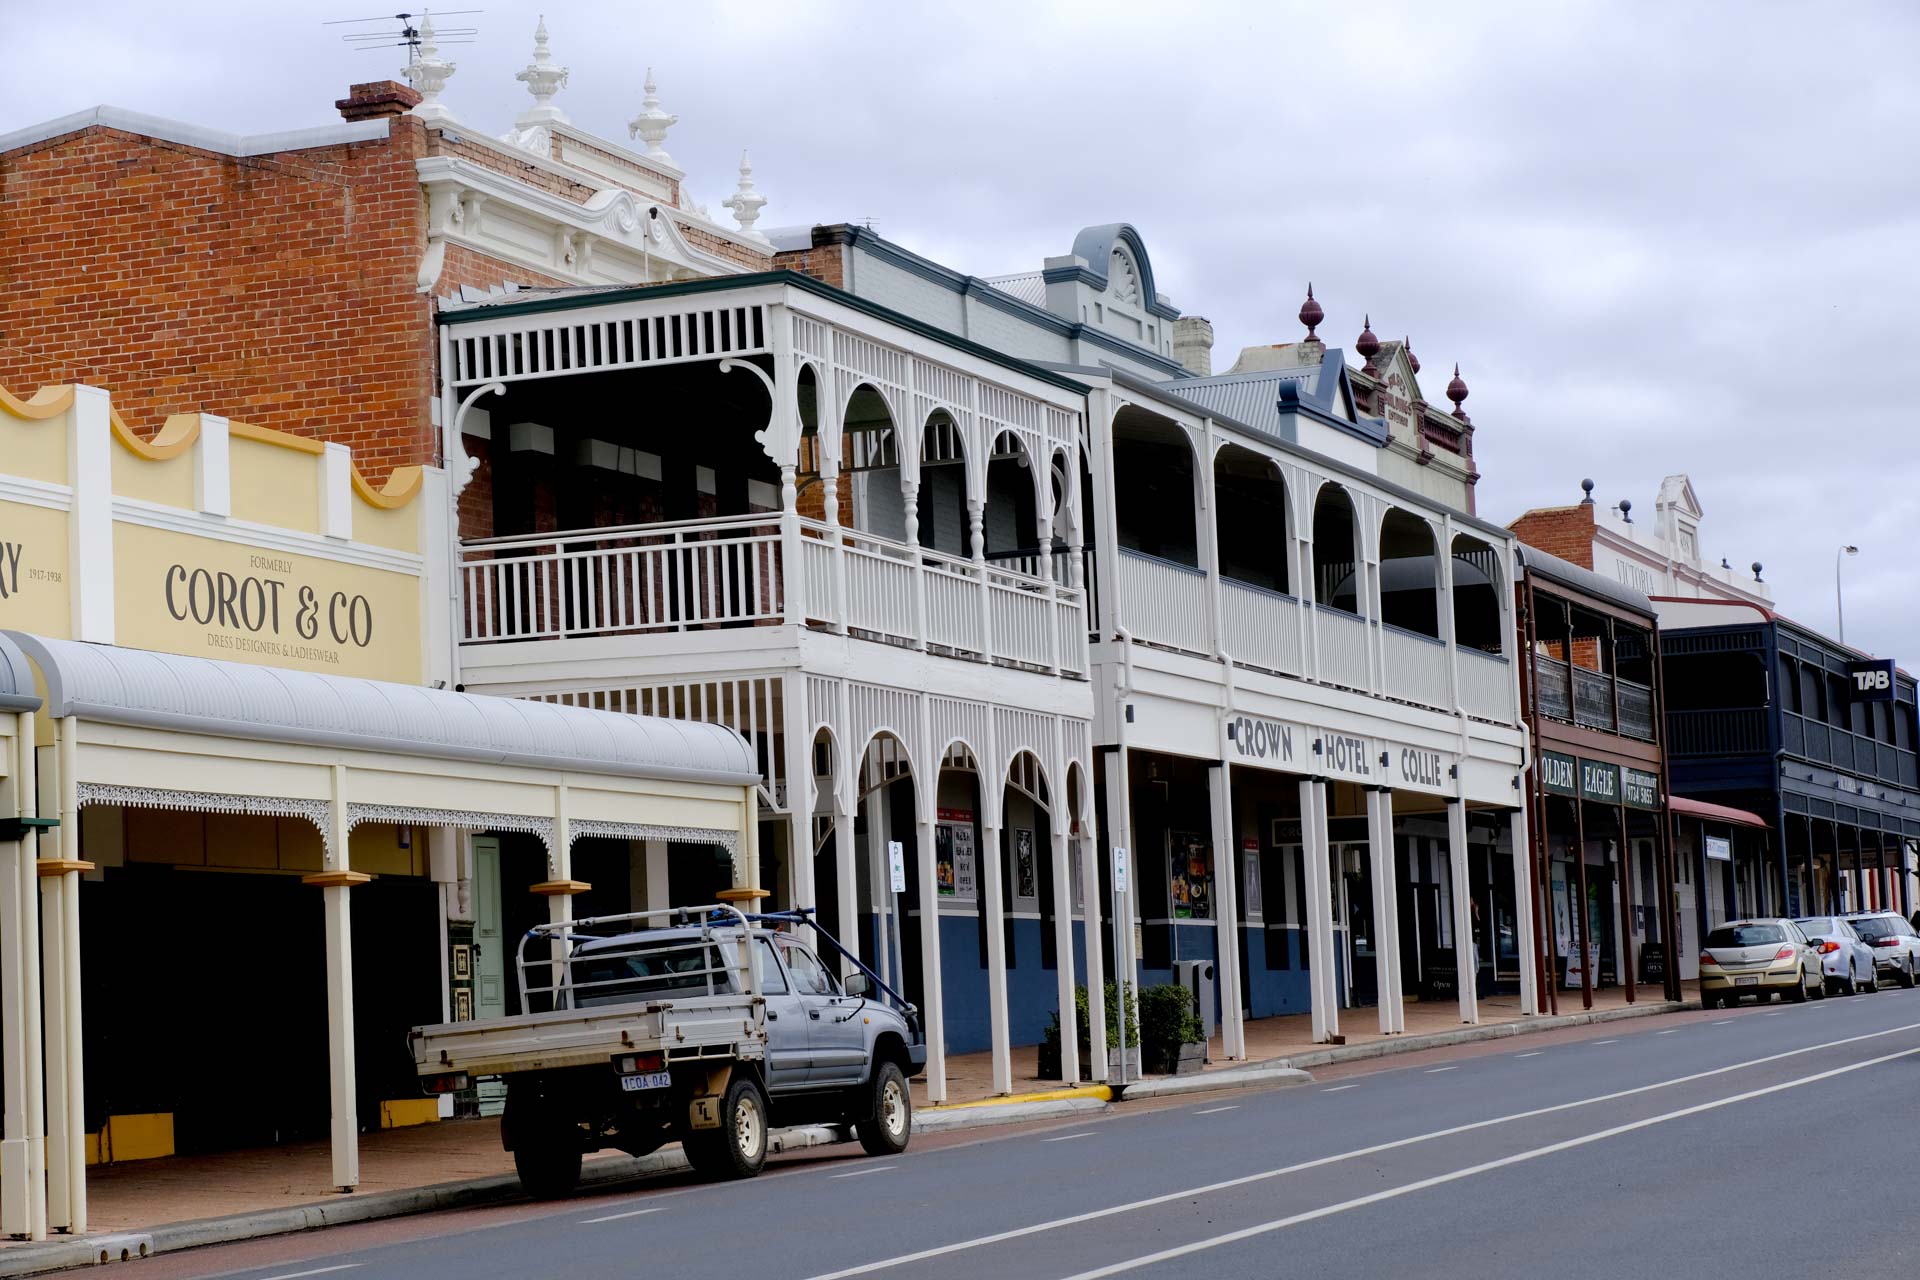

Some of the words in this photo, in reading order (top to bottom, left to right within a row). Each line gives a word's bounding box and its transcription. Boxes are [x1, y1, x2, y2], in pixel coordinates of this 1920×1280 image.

[29, 568, 62, 583] 1917-1938
[250, 555, 293, 574] FORMERLY
[1616, 558, 1655, 596] VICTORIA
[165, 564, 285, 635] COROT
[296, 585, 319, 640] &
[329, 591, 373, 648] CO
[207, 633, 233, 650] DRESS
[235, 637, 281, 656] DESIGNERS
[282, 644, 289, 657] &
[290, 645, 340, 664] LADIESWEAR
[1852, 670, 1890, 691] TAB
[1234, 716, 1293, 763] CROWN
[1325, 733, 1370, 776] HOTEL
[1401, 747, 1442, 787] COLLIE
[1584, 766, 1614, 796] EAGLE
[1432, 980, 1452, 990] Open
